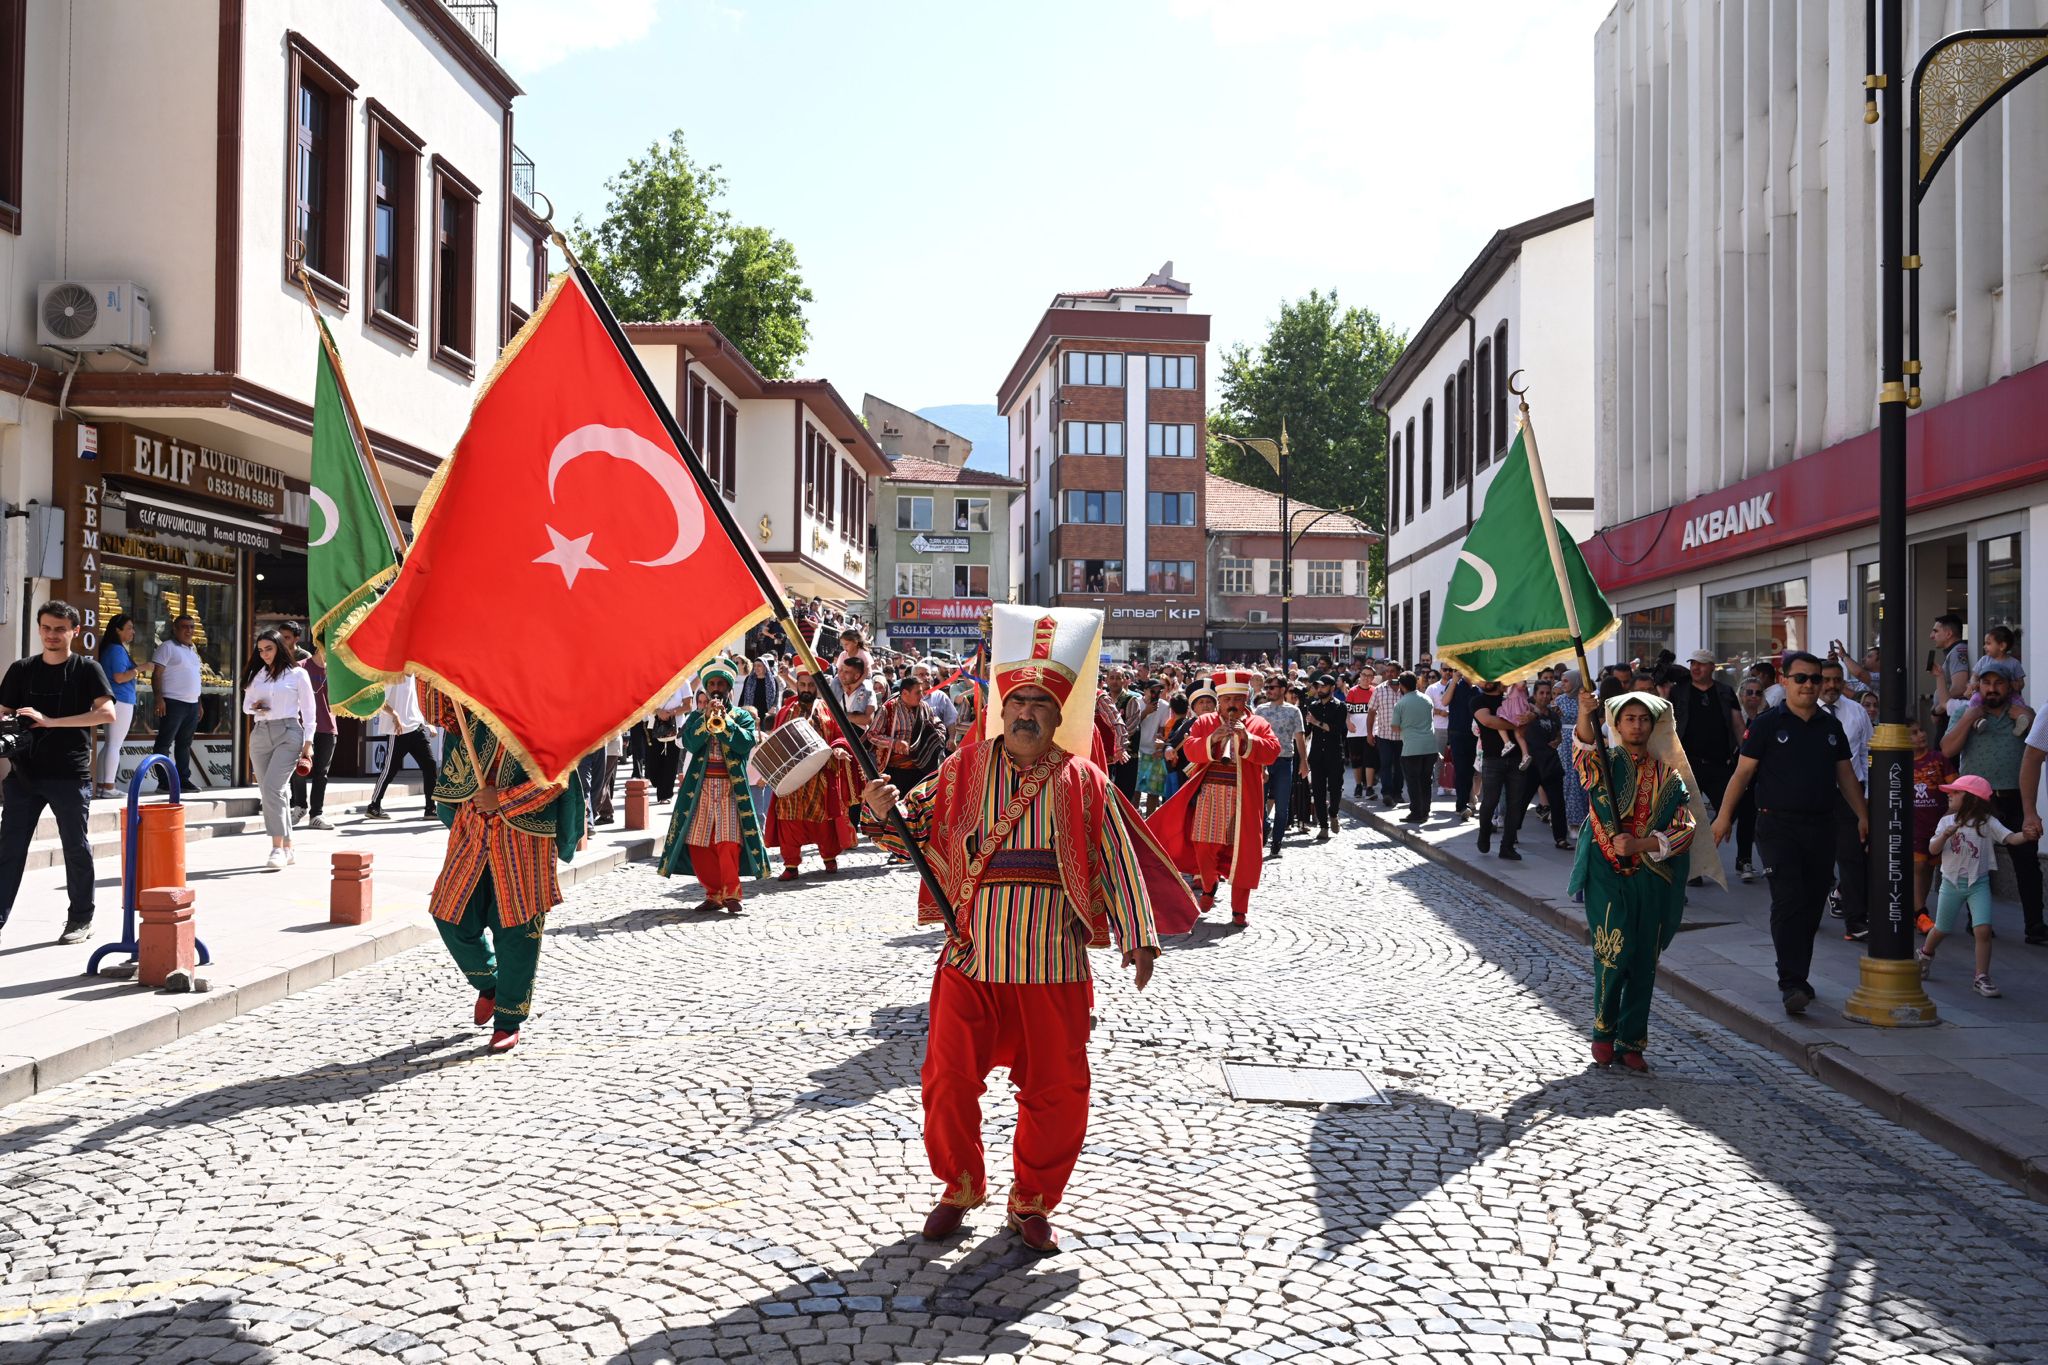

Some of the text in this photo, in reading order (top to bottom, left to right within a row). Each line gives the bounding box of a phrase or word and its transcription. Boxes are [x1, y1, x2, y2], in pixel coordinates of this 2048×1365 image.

[133, 435, 196, 486] ELİF
[200, 447, 287, 490] KUYUMCULUK
[82, 485, 99, 593] KEMAL
[139, 508, 269, 549] ELİF KUYUMCULUK Kemal BOZOĞLU
[1681, 491, 1775, 551] AKBANK
[892, 624, 981, 634] SAĞLIK ECZANES
